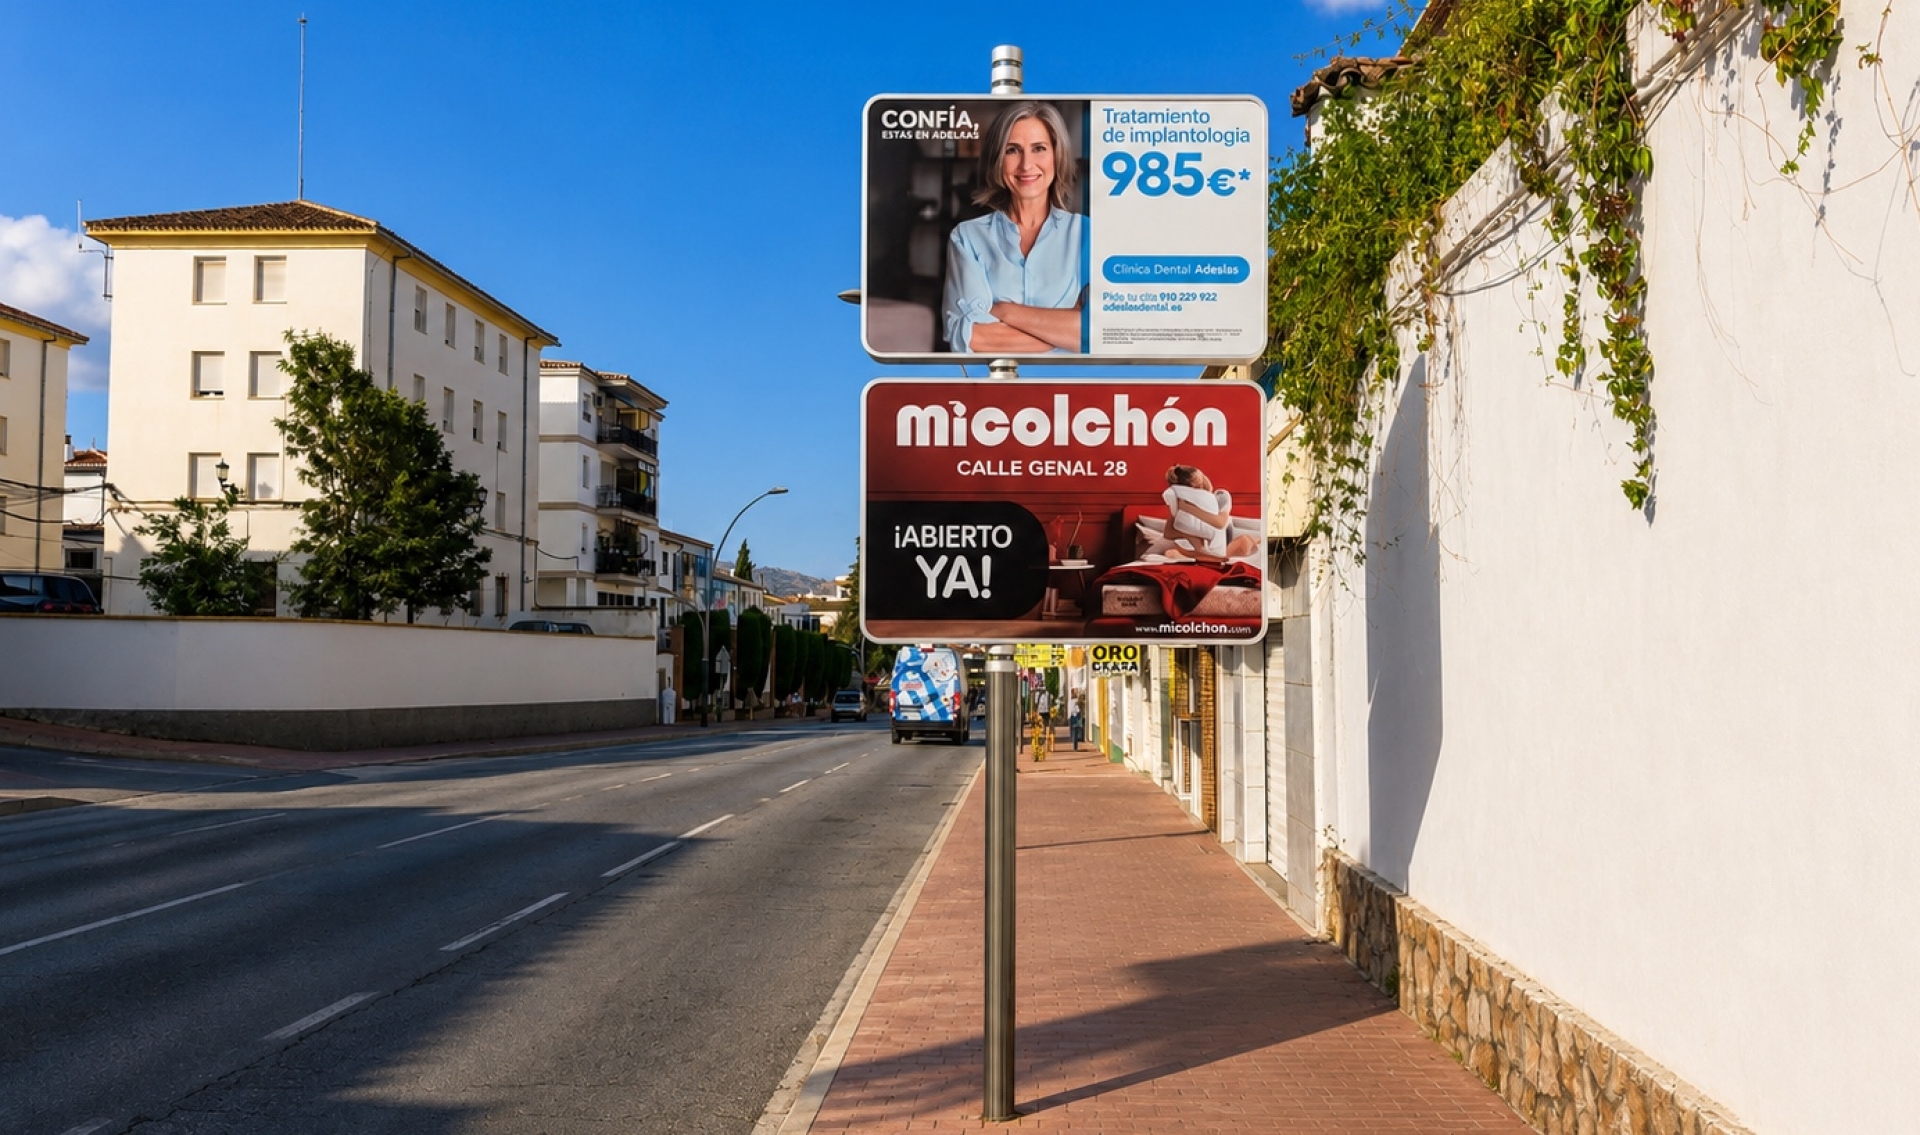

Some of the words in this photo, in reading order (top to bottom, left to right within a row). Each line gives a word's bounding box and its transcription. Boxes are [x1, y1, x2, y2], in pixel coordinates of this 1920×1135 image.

[881, 104, 979, 132] CONFÍA,
[1102, 108, 1211, 124] Tratamiento
[915, 130, 930, 139] EN
[1102, 127, 1125, 143] de
[1130, 127, 1250, 147] implantologia
[1154, 263, 1191, 275] Dental
[1195, 263, 1239, 275] Adeslas
[1127, 292, 1138, 302] tu
[1159, 292, 1177, 302] 910
[1179, 292, 1197, 302] 229
[1199, 292, 1218, 302] 922
[896, 394, 1227, 447] micolchón
[956, 460, 1023, 476] CALLE
[1028, 460, 1098, 476] GENAL
[1103, 460, 1128, 476] 28
[894, 525, 1013, 548] ¡ABIERTO
[915, 554, 992, 599] YA!
[1135, 621, 1252, 634] www.micolchon.com
[1092, 645, 1138, 660] ORO
